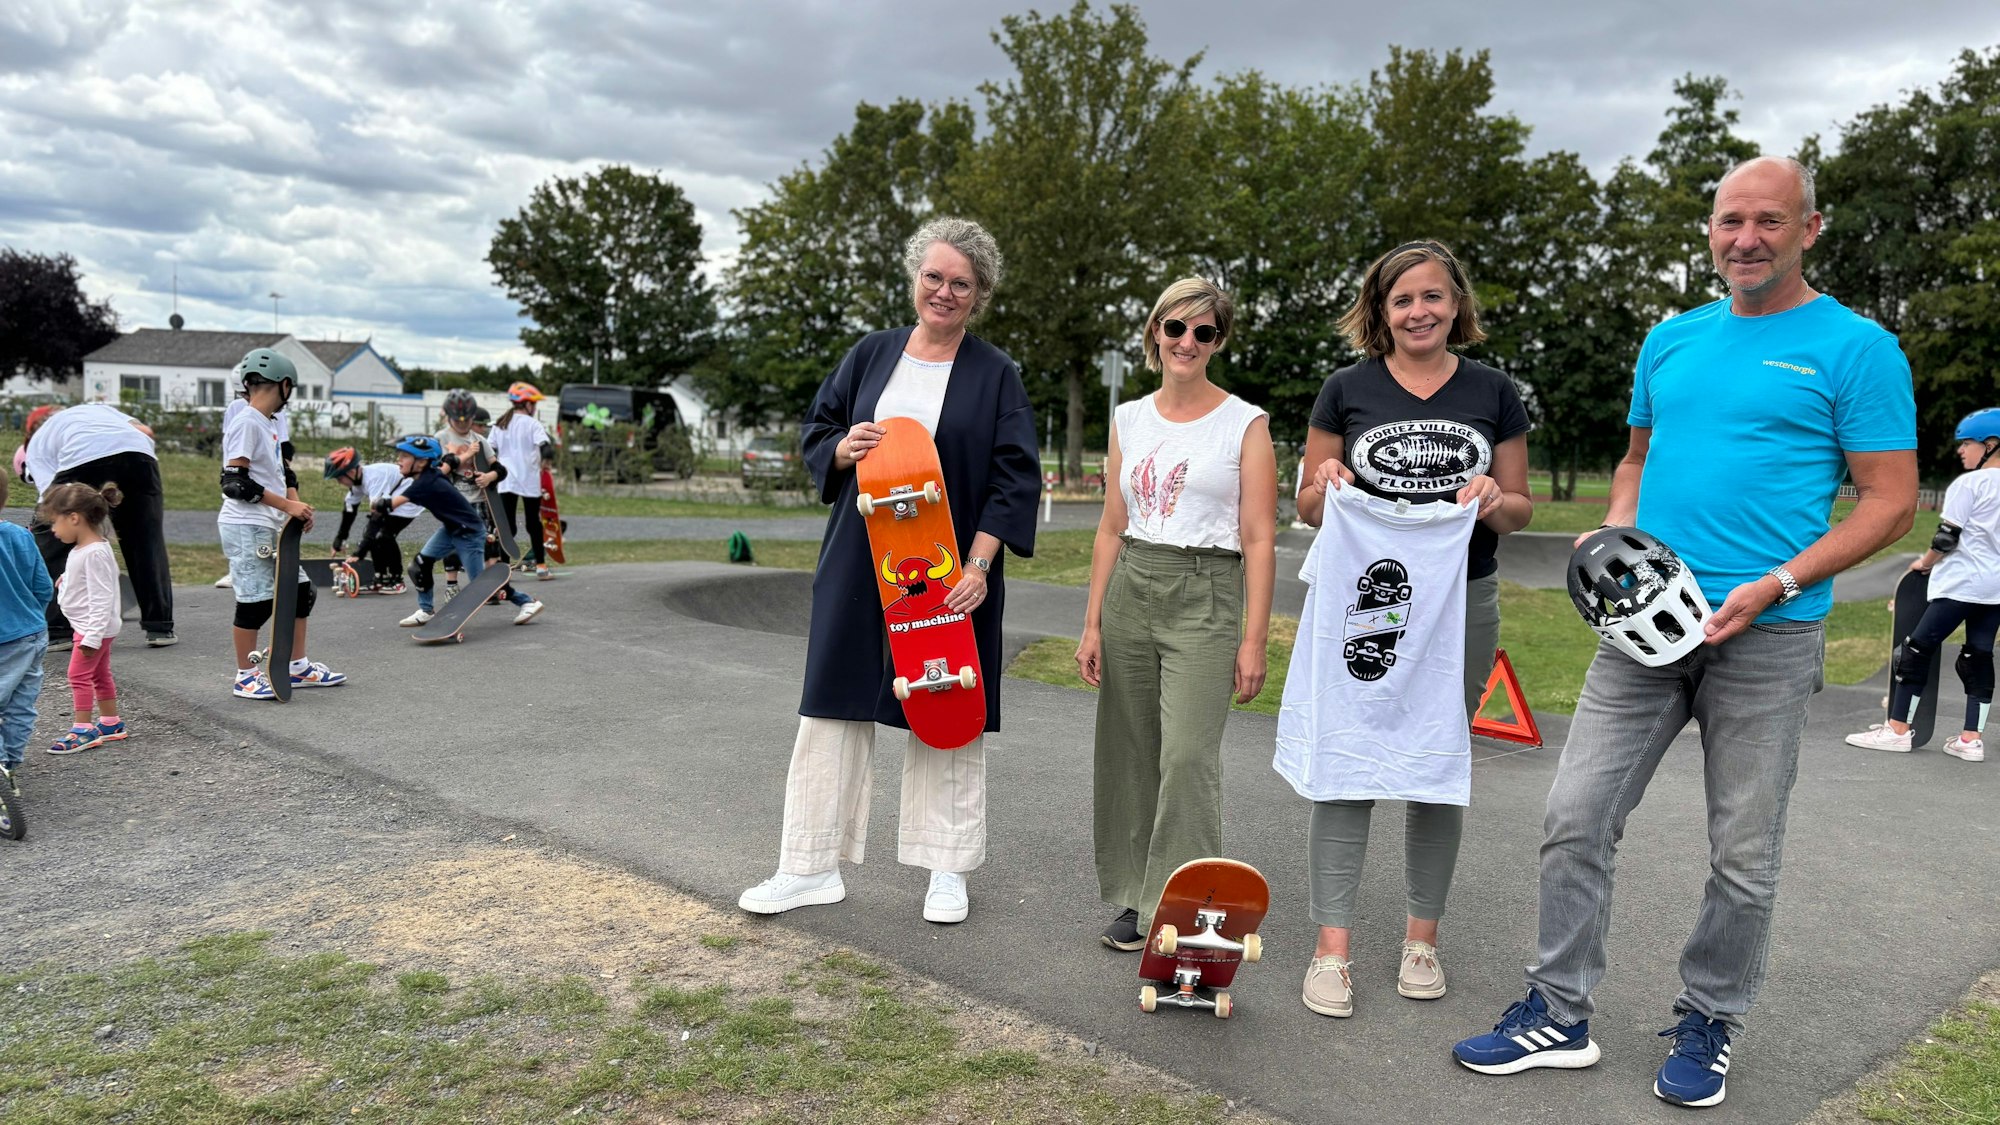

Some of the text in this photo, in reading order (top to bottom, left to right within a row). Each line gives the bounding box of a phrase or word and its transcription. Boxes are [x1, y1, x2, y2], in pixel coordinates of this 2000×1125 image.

[1762, 359, 1817, 376] westenergie
[1365, 423, 1475, 443] CORTEZ VILLAGE
[1378, 475, 1468, 490] FLORIDA
[889, 612, 966, 633] toy machine
